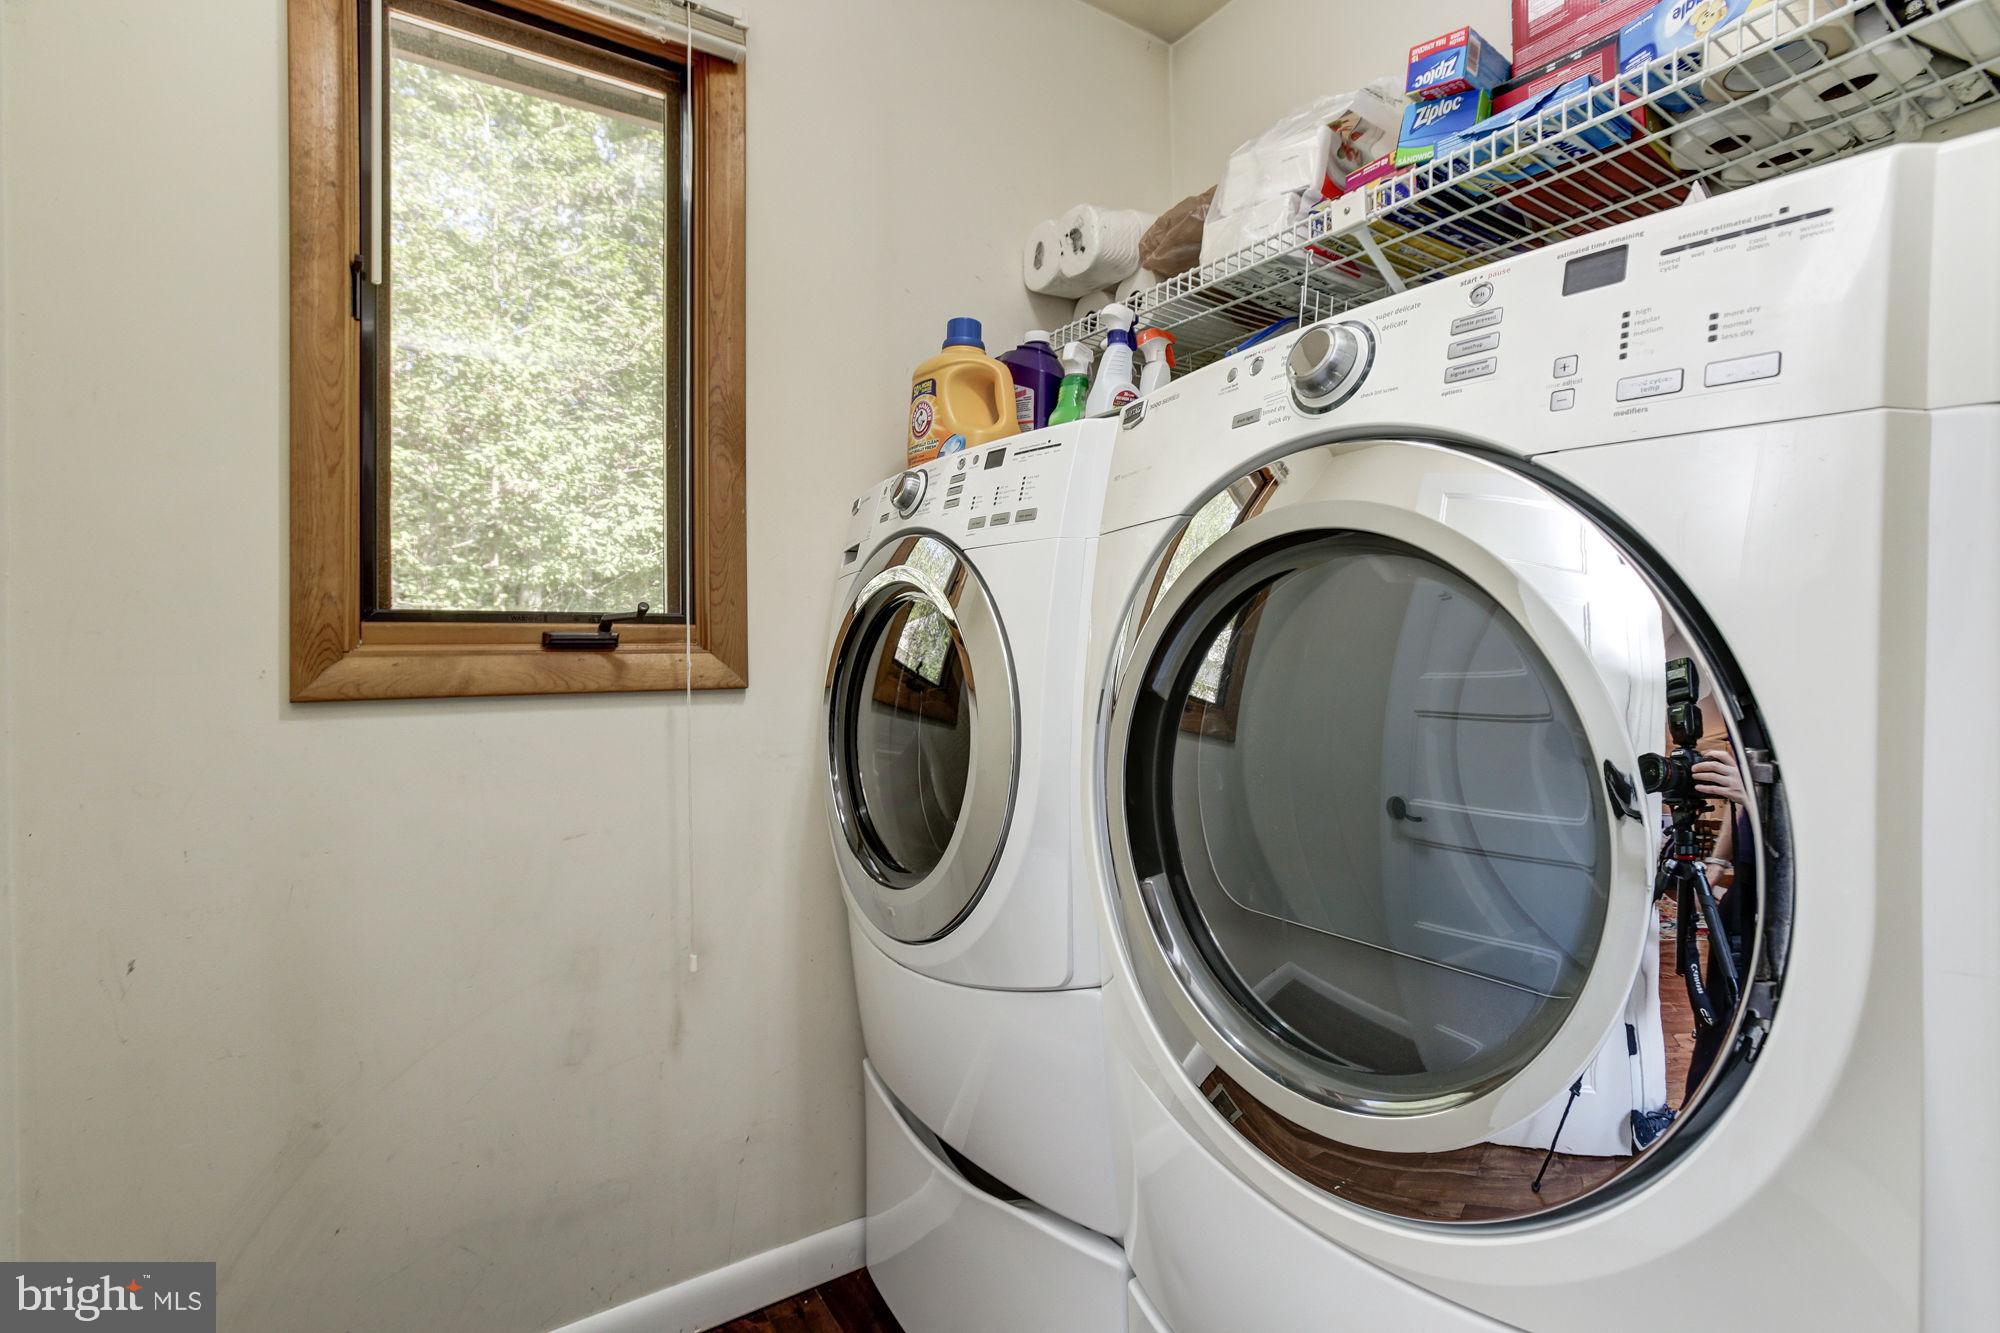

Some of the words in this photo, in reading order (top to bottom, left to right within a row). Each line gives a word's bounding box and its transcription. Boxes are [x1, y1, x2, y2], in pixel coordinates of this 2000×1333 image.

[1415, 57, 1457, 87] Ziploc
[1412, 97, 1461, 129] Ziploc
[1678, 227, 1708, 240] sensing
[1711, 218, 1751, 233] estimated
[1754, 212, 1773, 221] time
[1557, 245, 1590, 260] estimated
[1591, 239, 1606, 251] time
[1607, 231, 1644, 248] remaining
[1659, 257, 1680, 268] timed
[1713, 244, 1736, 255] damp
[1778, 230, 1792, 239] dry
[1660, 264, 1679, 273] cycle
[1460, 276, 1478, 288] start
[1487, 267, 1512, 280] pause
[1375, 310, 1394, 321] super
[1394, 302, 1422, 315] delicate
[1723, 308, 1746, 318] more
[1747, 304, 1761, 314] dry
[1381, 318, 1408, 332] delicate
[1633, 315, 1660, 326] regular
[1722, 319, 1752, 330] normal
[1633, 326, 1664, 337] medium
[1740, 328, 1755, 338] dry
[1441, 388, 1463, 397] options
[1613, 406, 1648, 417] modifiers
